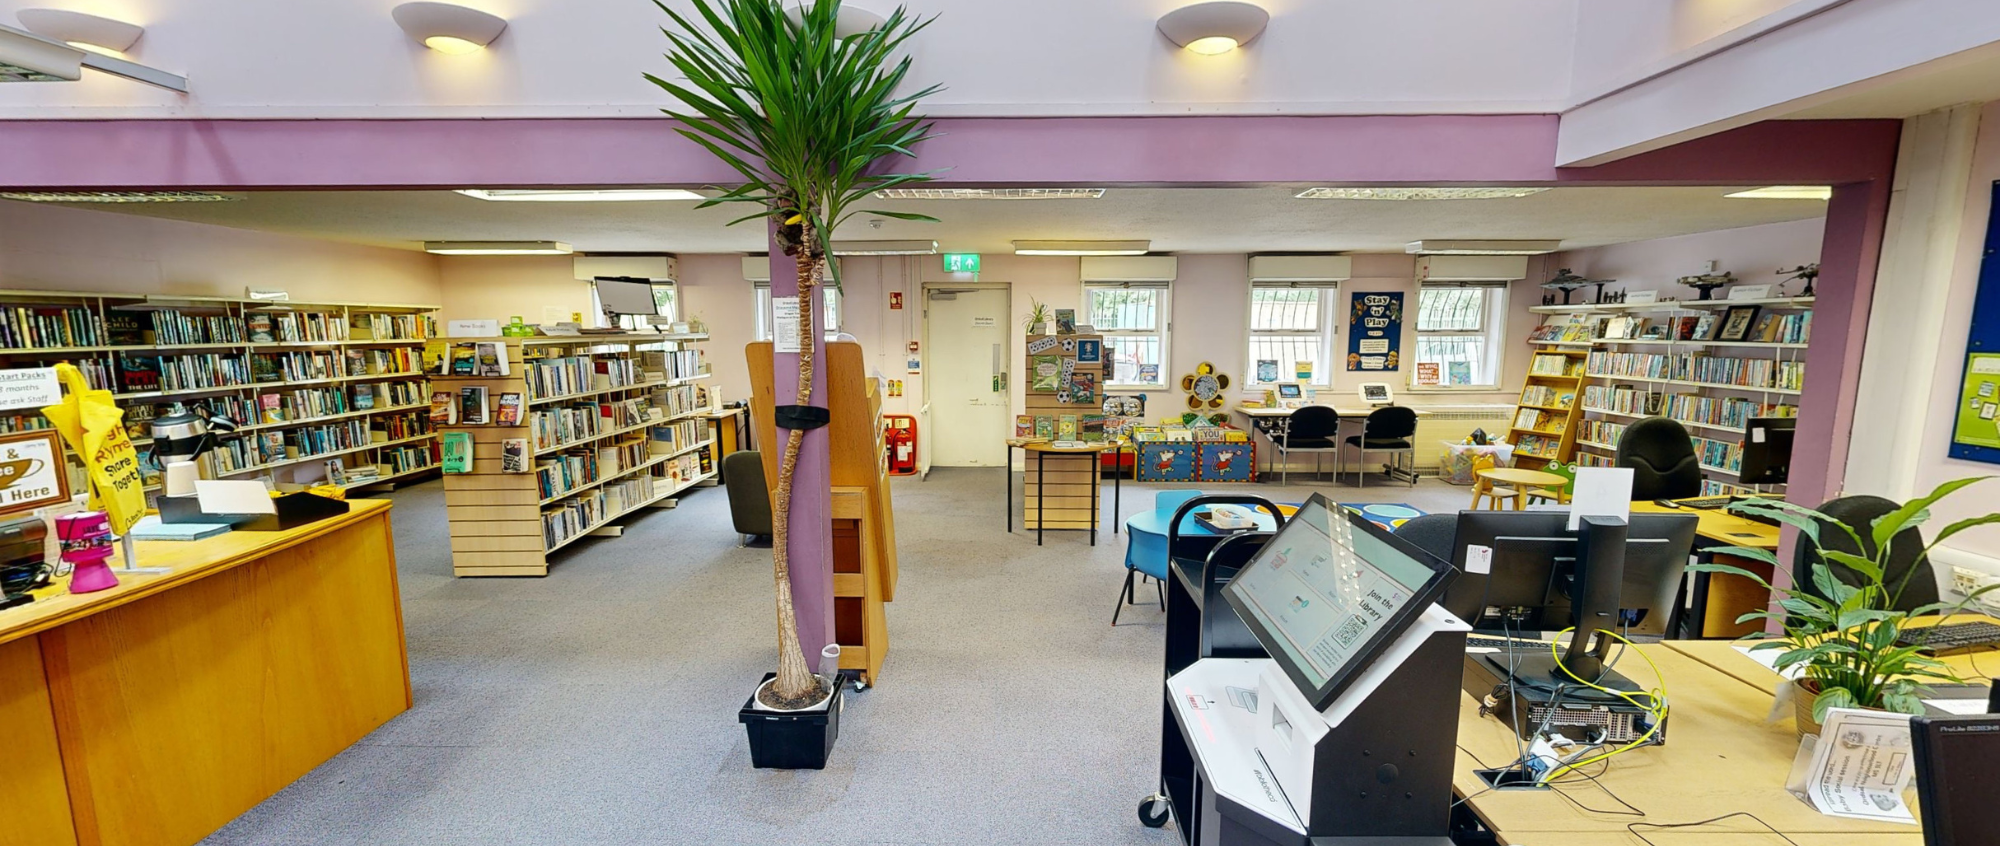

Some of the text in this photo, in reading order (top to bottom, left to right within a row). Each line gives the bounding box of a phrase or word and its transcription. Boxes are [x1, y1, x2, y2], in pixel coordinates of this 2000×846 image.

[1366, 296, 1389, 306] Stay
[1366, 318, 1388, 328] Play
[7, 448, 20, 459] &
[11, 486, 50, 500] Here
[1367, 589, 1382, 602] Join
[1381, 598, 1394, 610] the
[1359, 600, 1383, 622] Library
